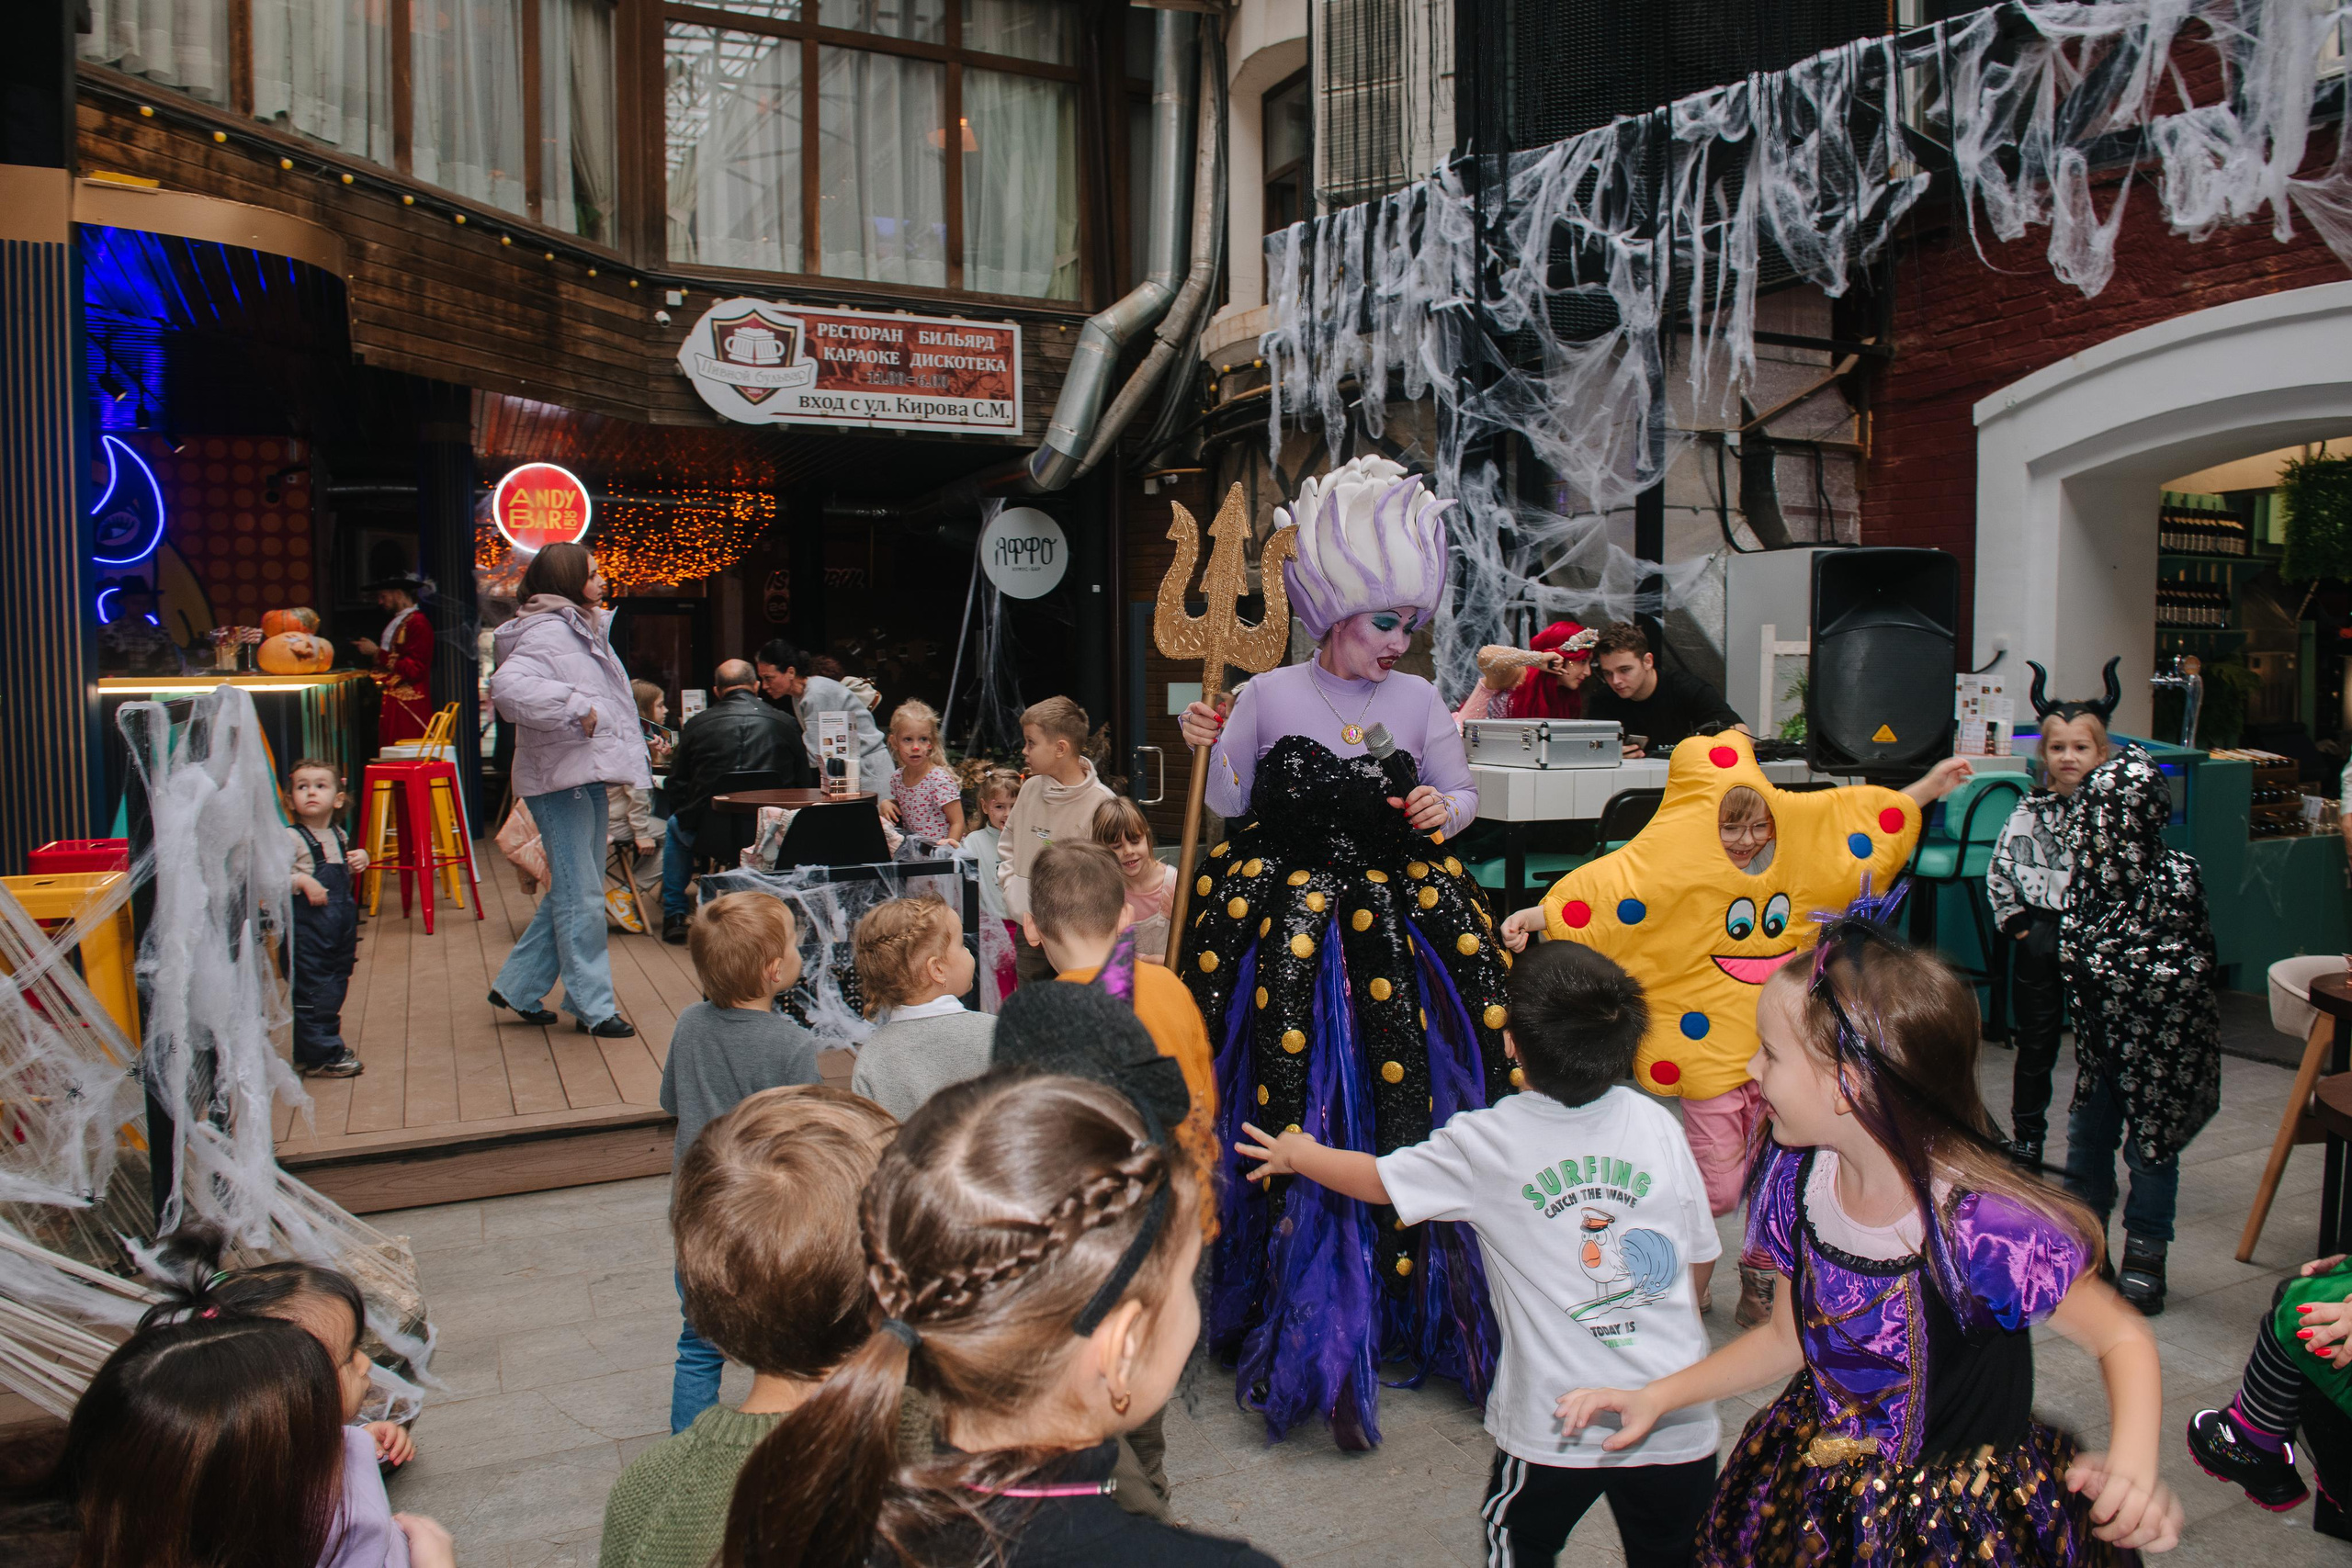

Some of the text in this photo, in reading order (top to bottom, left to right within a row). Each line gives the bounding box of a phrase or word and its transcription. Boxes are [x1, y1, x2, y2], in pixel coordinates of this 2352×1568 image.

[817, 322, 995, 351] РЕСТОРАН БИЛЬЯРД
[823, 346, 1007, 372] КАРАОКЕ ДИСКОТЕКА
[701, 359, 806, 386] Пивной бульвар
[798, 395, 846, 413] вход
[851, 398, 860, 411] с
[865, 398, 891, 416] ул.
[897, 397, 968, 419] Кирова
[508, 488, 577, 509] ANDY
[509, 509, 562, 529] BAR
[768, 602, 788, 613] 24
[1521, 1156, 1652, 1210] SURFING
[1544, 1188, 1638, 1219] CATCH THE WAVE
[1589, 1321, 1636, 1337] TODAY IS
